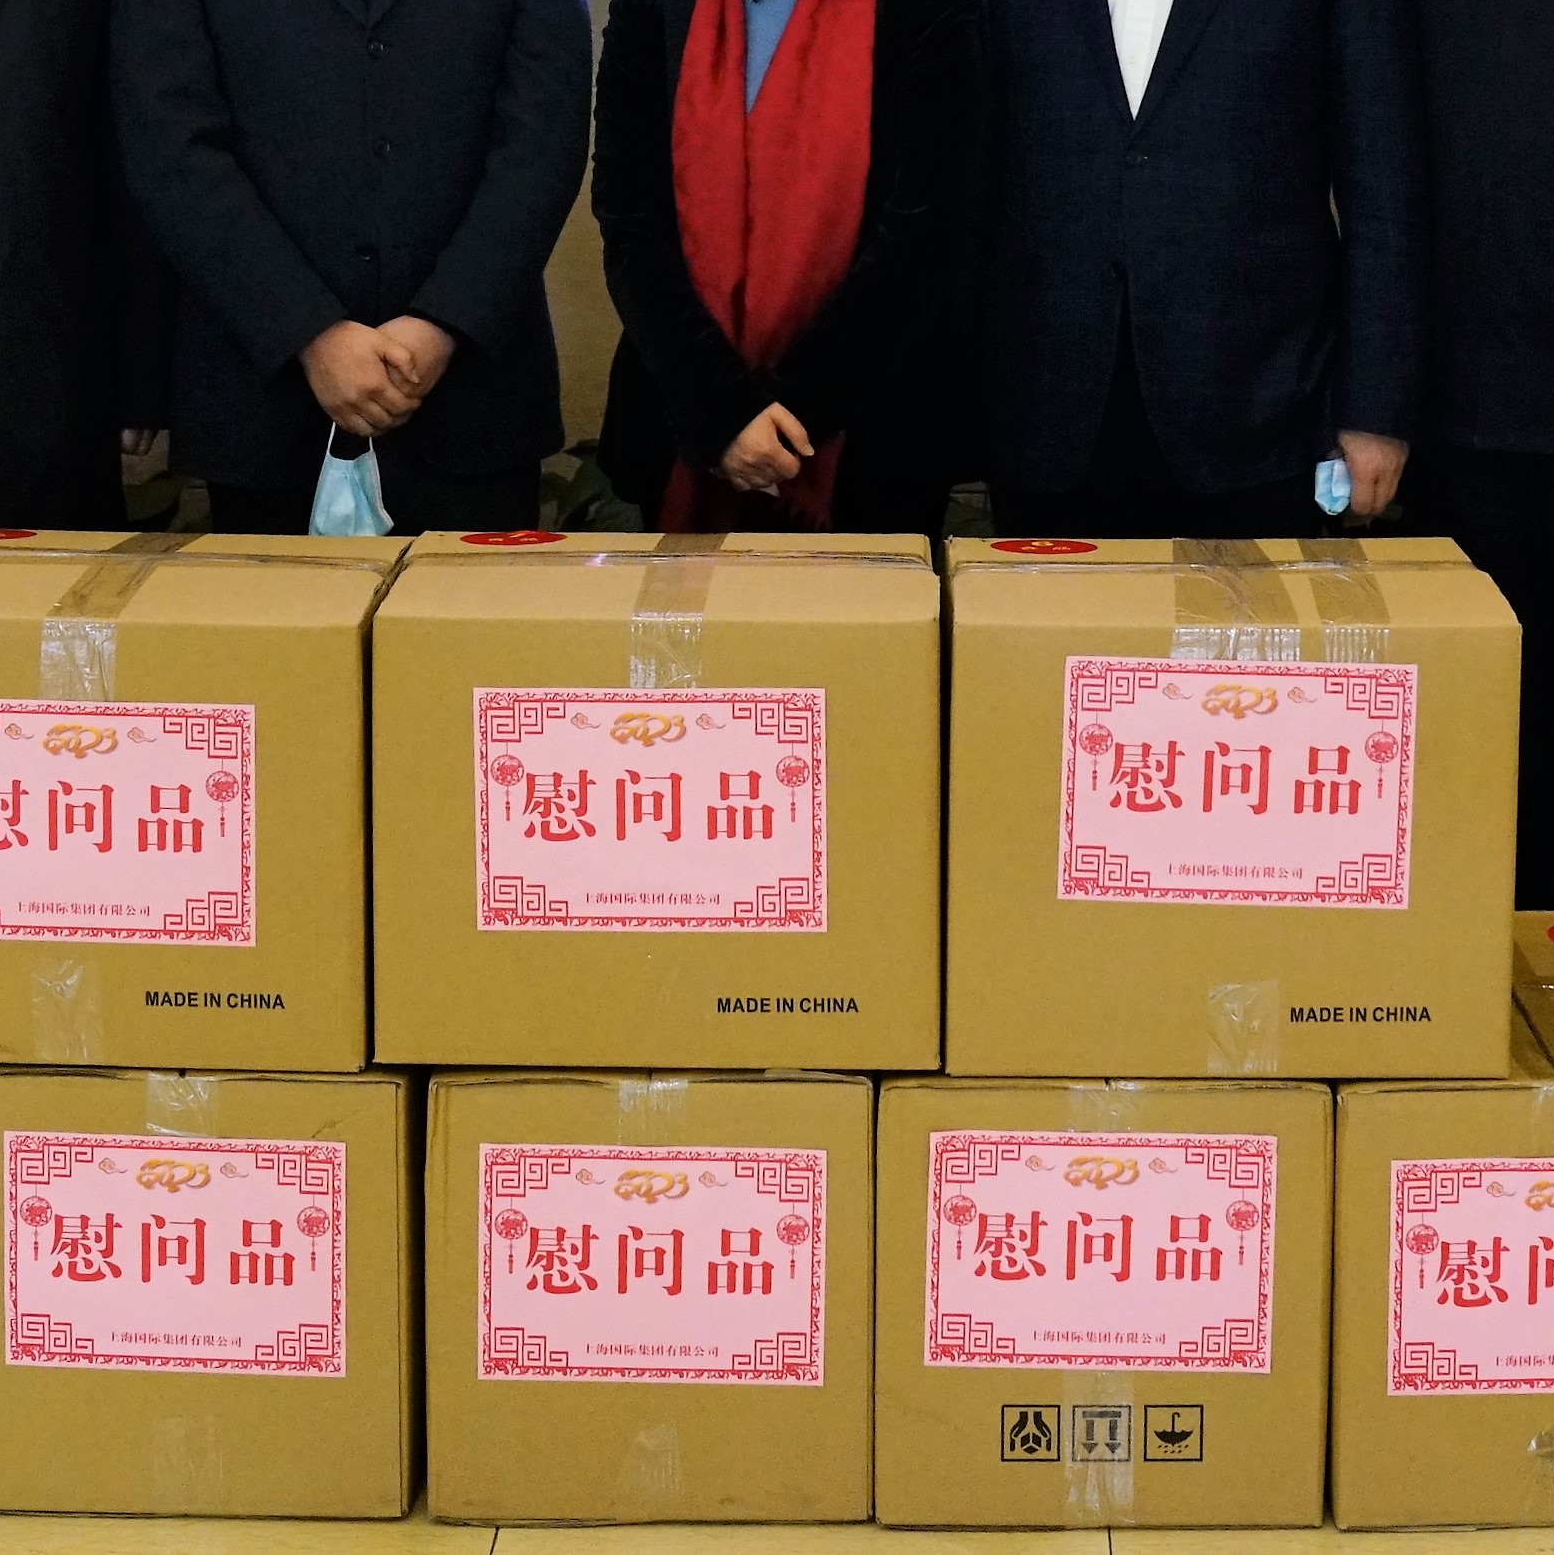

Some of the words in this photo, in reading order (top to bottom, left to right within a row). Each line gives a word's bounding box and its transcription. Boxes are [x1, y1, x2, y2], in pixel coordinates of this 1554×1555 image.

[1109, 740, 1362, 816] 慰问品
[523, 768, 775, 843] 慰问品
[1167, 862, 1304, 881] 上海国际集团有限公司
[585, 891, 721, 906] 上海国际集团有限公司
[17, 900, 151, 918] 上海国际集团有限公司
[146, 991, 198, 1007] MADE
[204, 993, 220, 1007] IN
[227, 994, 285, 1009] CHINA
[718, 998, 770, 1012] MADE
[777, 998, 793, 1012] IN
[800, 998, 858, 1013] CHINA
[1291, 1008, 1343, 1022] MADE
[1350, 1008, 1366, 1022] IN
[1373, 1007, 1431, 1022] CHINA
[50, 1212, 296, 1287] 慰问品
[973, 1210, 1223, 1283] 慰问品
[523, 1219, 775, 1298] 慰问品
[110, 1330, 243, 1349] 上海国际集团有限公司
[1032, 1329, 1167, 1346] 上海国际集团有限公司
[585, 1342, 720, 1359] 上海国际集团有限公司
